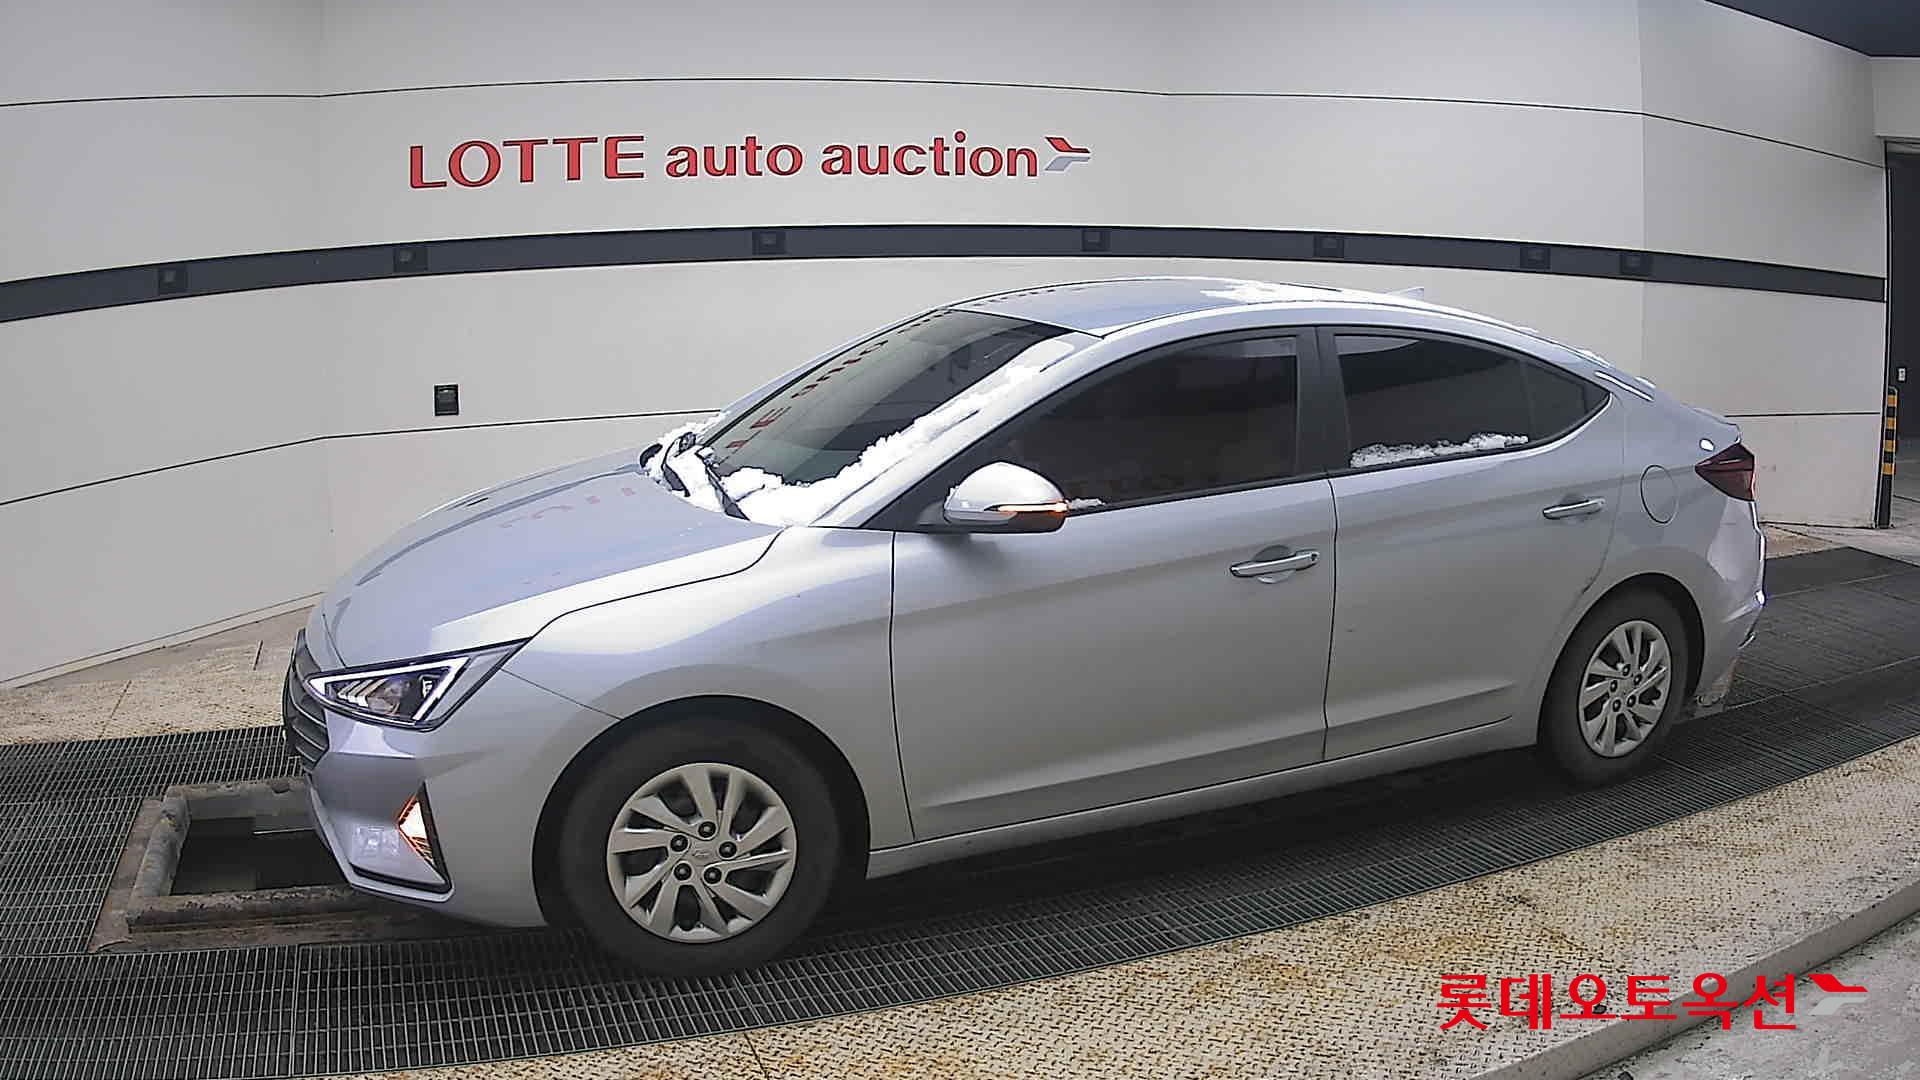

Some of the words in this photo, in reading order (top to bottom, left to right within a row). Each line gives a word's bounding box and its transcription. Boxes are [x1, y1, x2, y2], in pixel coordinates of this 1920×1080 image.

[409, 135, 645, 189] LOTTE
[665, 136, 805, 177] auto
[821, 130, 1039, 178] auction
